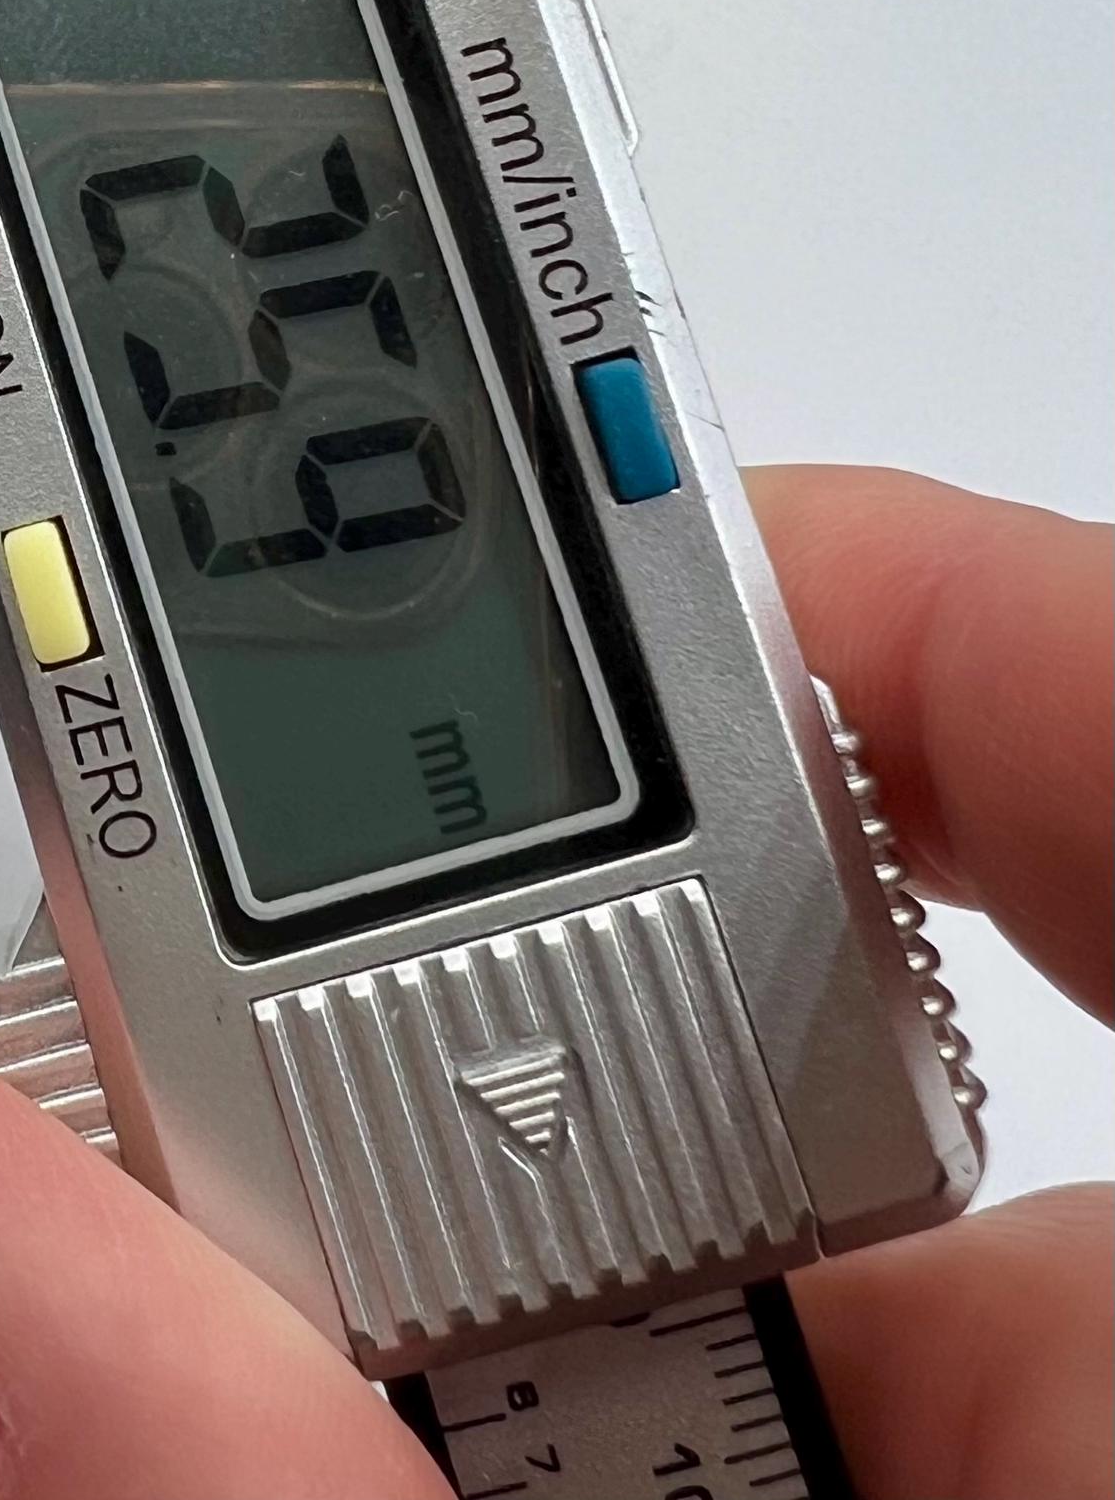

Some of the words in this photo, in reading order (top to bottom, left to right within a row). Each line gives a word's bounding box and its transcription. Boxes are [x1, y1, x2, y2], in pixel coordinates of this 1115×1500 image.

[460, 37, 613, 345] mm/inch
[80, 135, 465, 577] 25.9
[410, 719, 487, 834] mm
[55, 673, 158, 861] ZERO
[526, 1444, 560, 1471] 7
